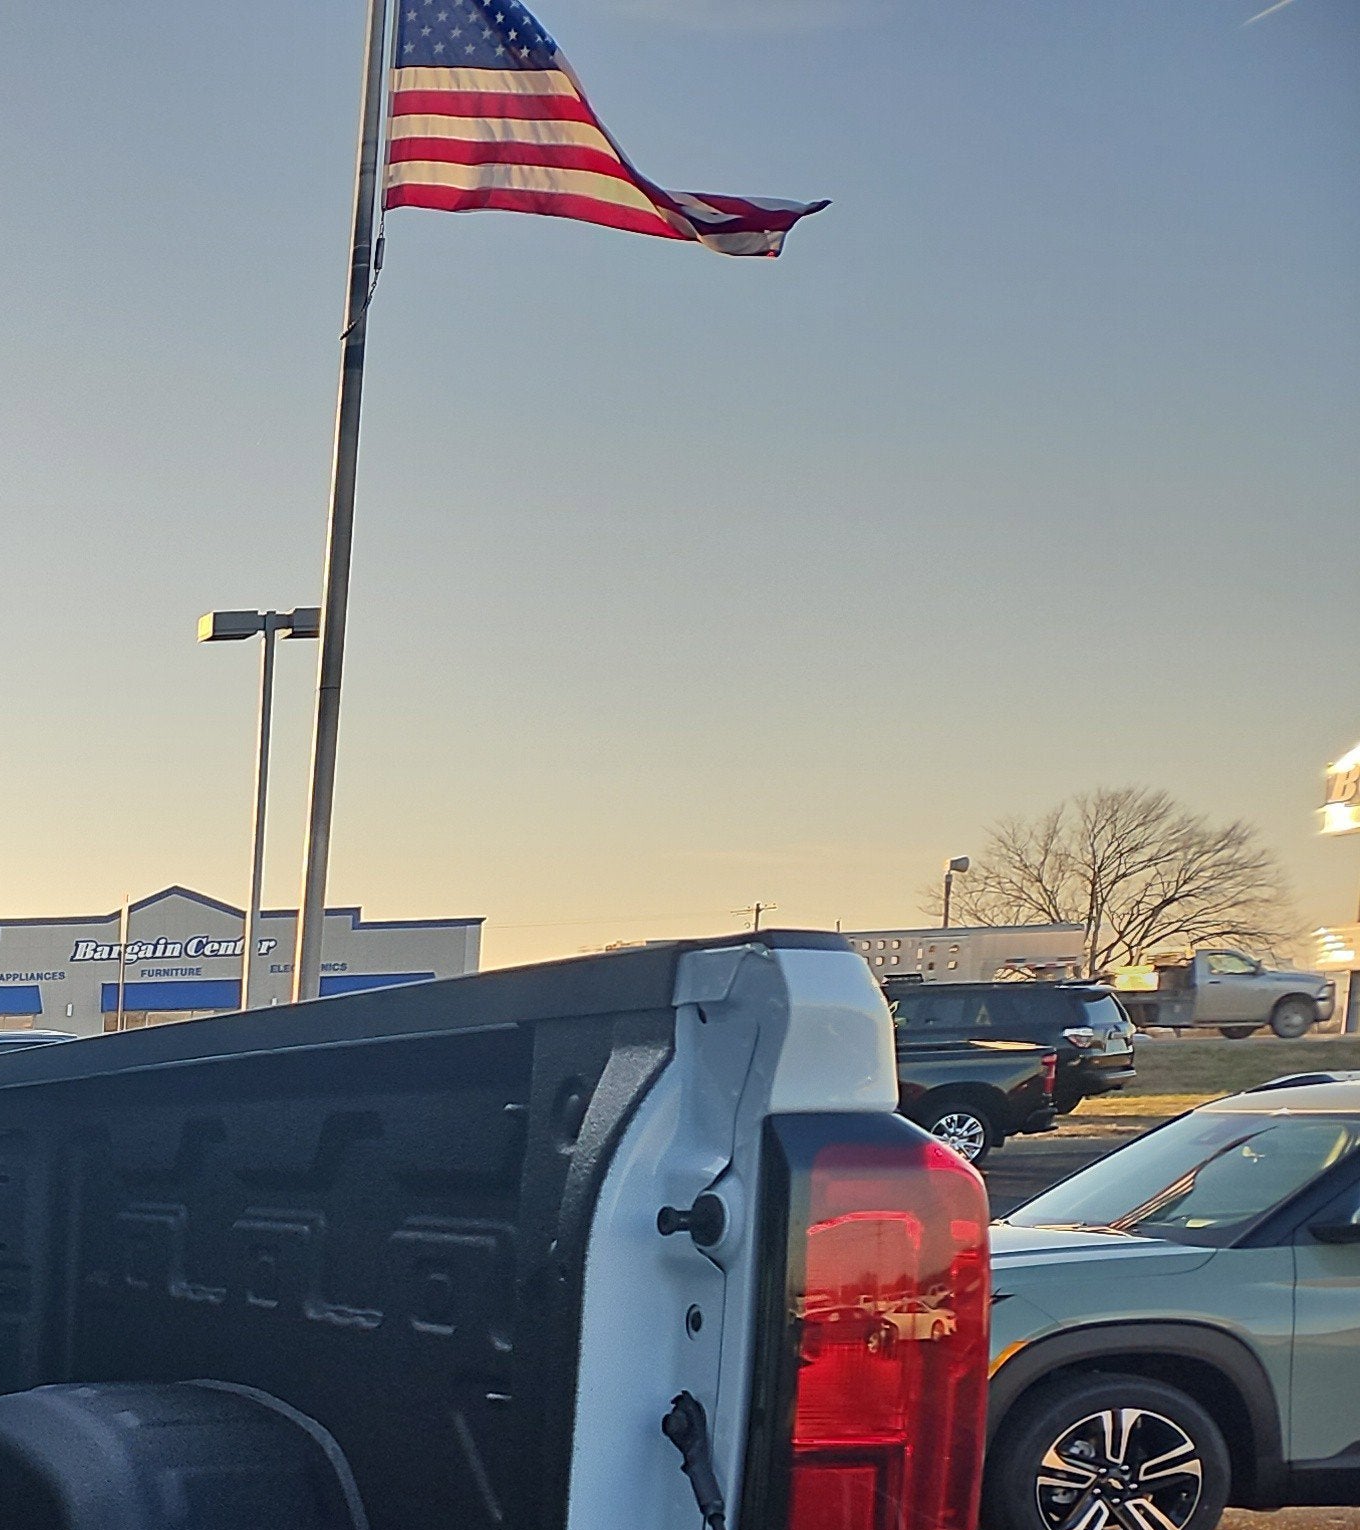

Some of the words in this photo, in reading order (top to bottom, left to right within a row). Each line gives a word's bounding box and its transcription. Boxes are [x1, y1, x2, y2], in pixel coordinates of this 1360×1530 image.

[70, 937, 183, 965] Bargain
[186, 935, 277, 958] Centr
[140, 967, 202, 978] FURNITURE
